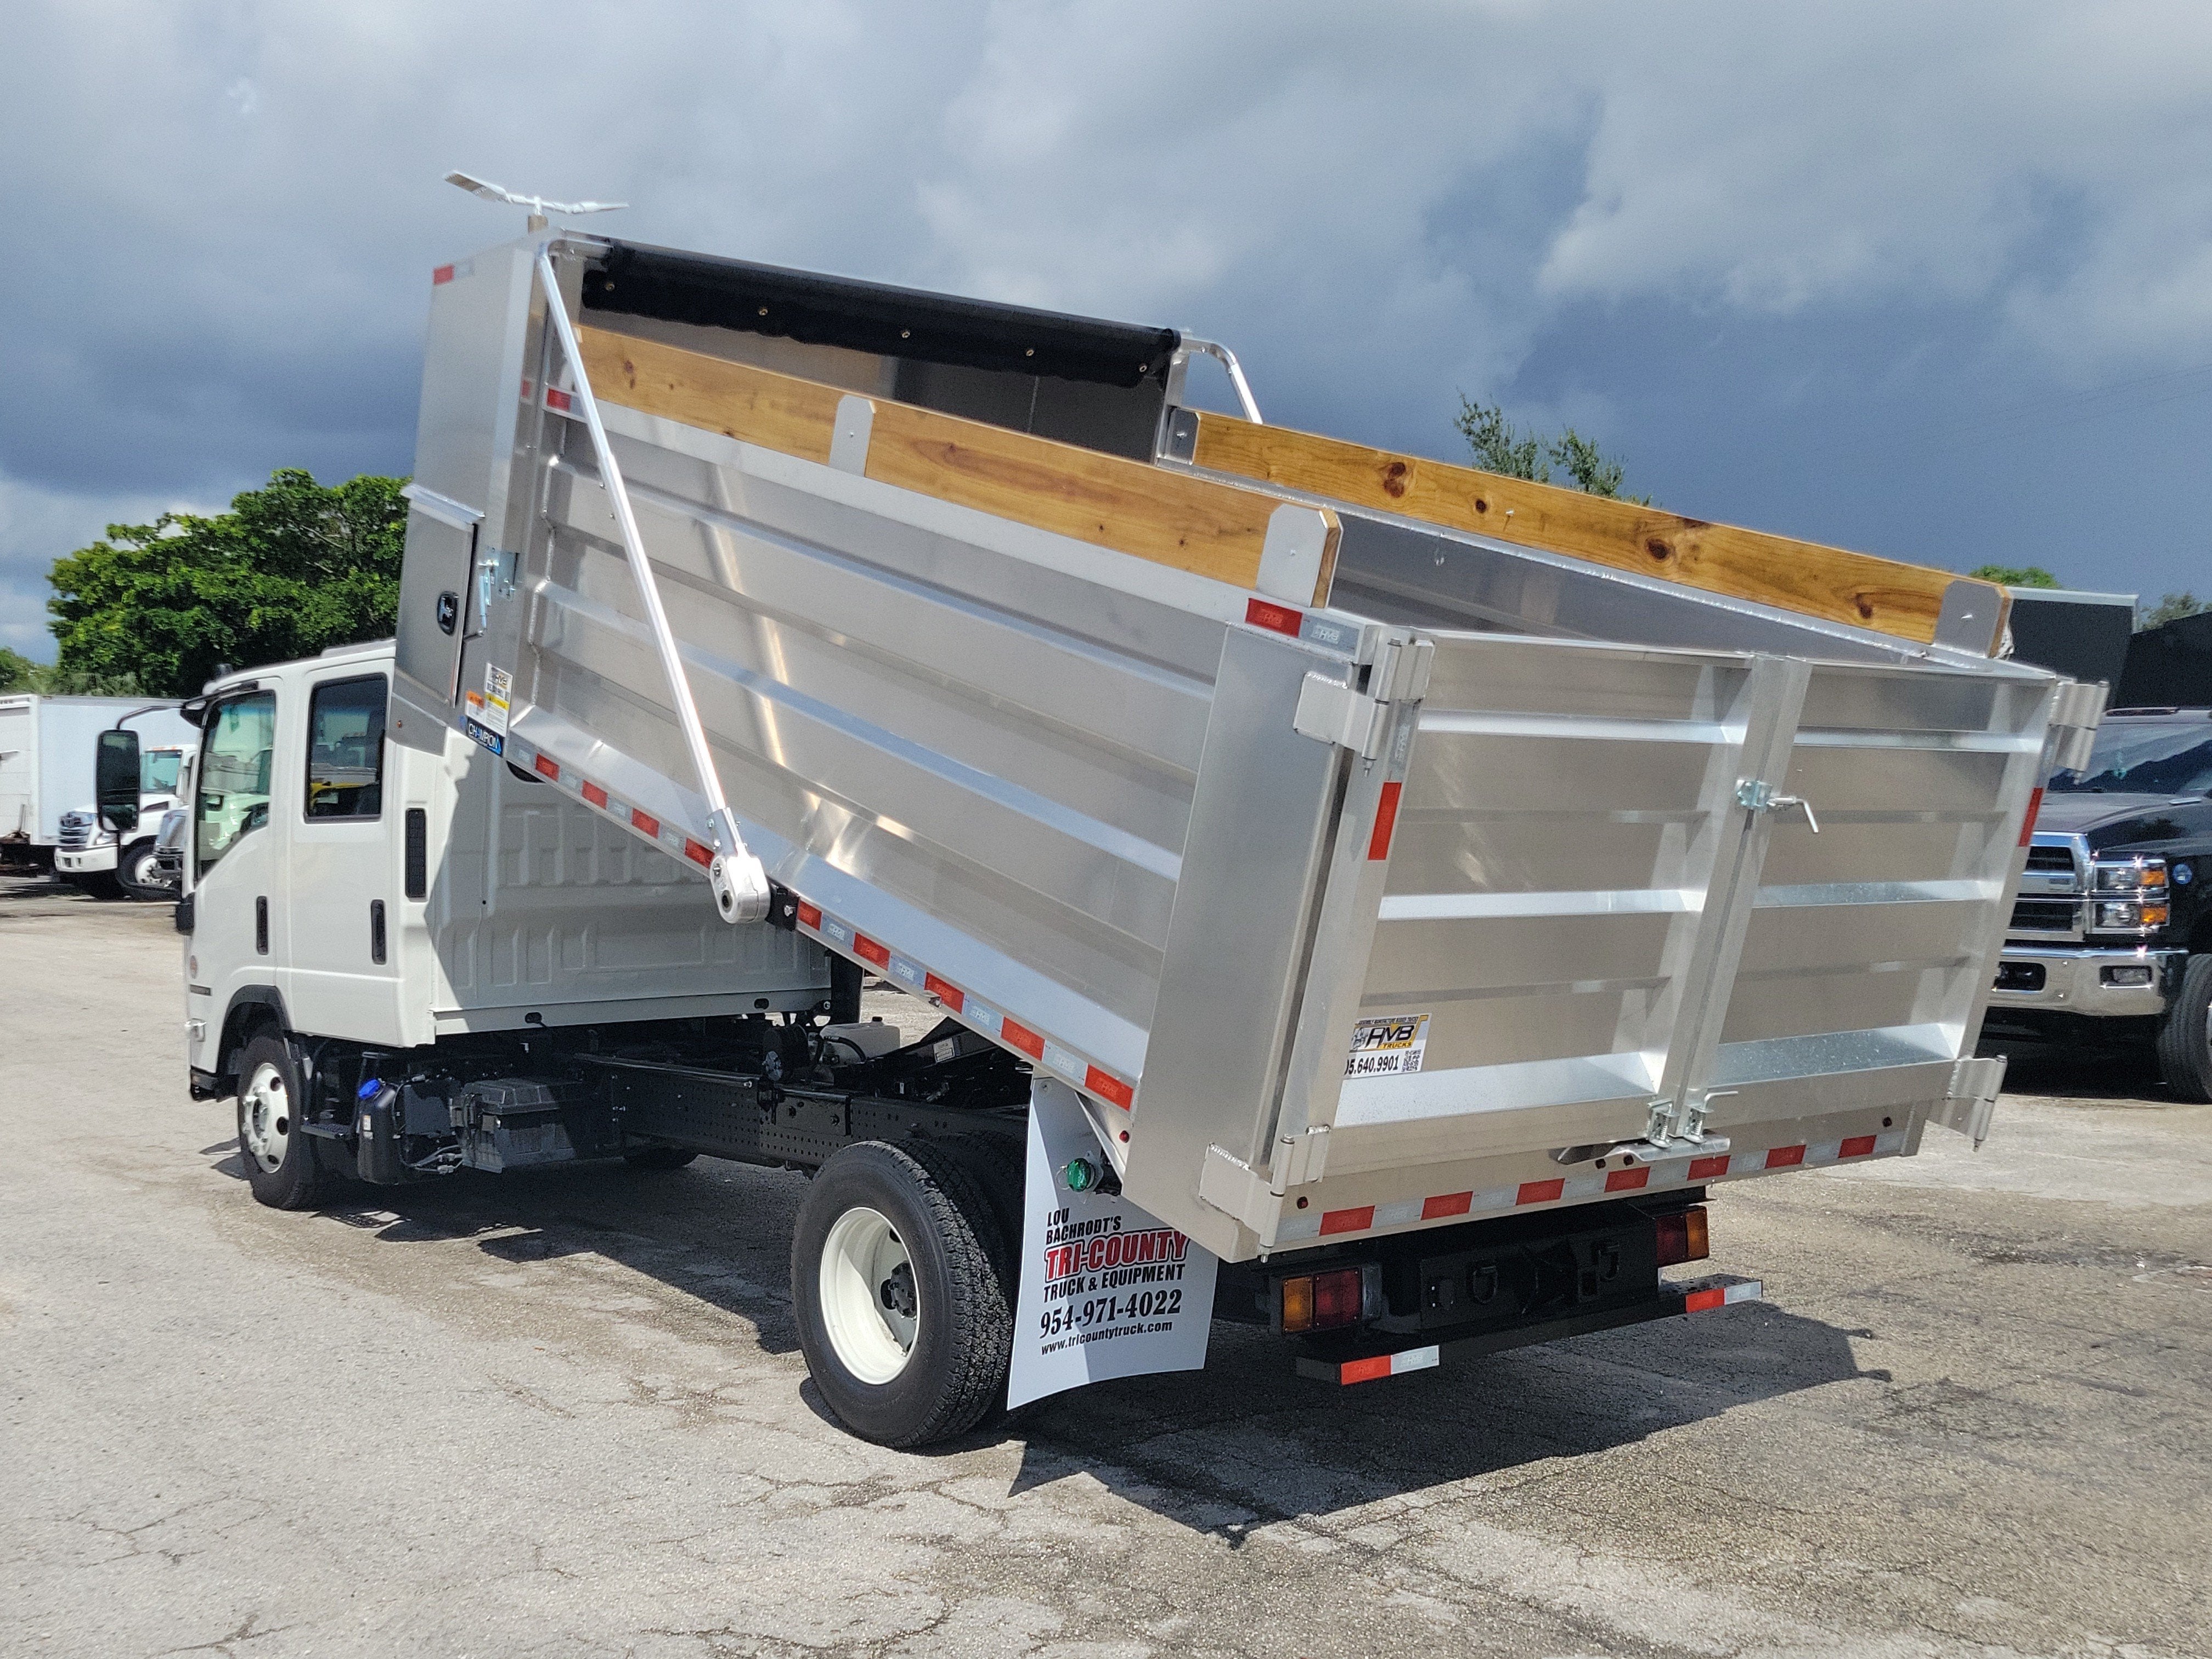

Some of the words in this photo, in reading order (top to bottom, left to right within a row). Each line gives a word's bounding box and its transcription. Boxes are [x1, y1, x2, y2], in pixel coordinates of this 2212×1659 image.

[1365, 1025, 1415, 1048] AMB
[1046, 1216, 1121, 1245] BACHRODT'S
[1047, 1207, 1070, 1227] LOU
[1045, 1229, 1190, 1282] TRI-COUNTY
[1043, 1279, 1085, 1303] TRUCK
[1088, 1277, 1097, 1291] &
[1101, 1263, 1185, 1289] EQUIPMENT
[1039, 1289, 1182, 1339] 954-971-4022
[1041, 1321, 1172, 1355] www.tricountytruck.com
